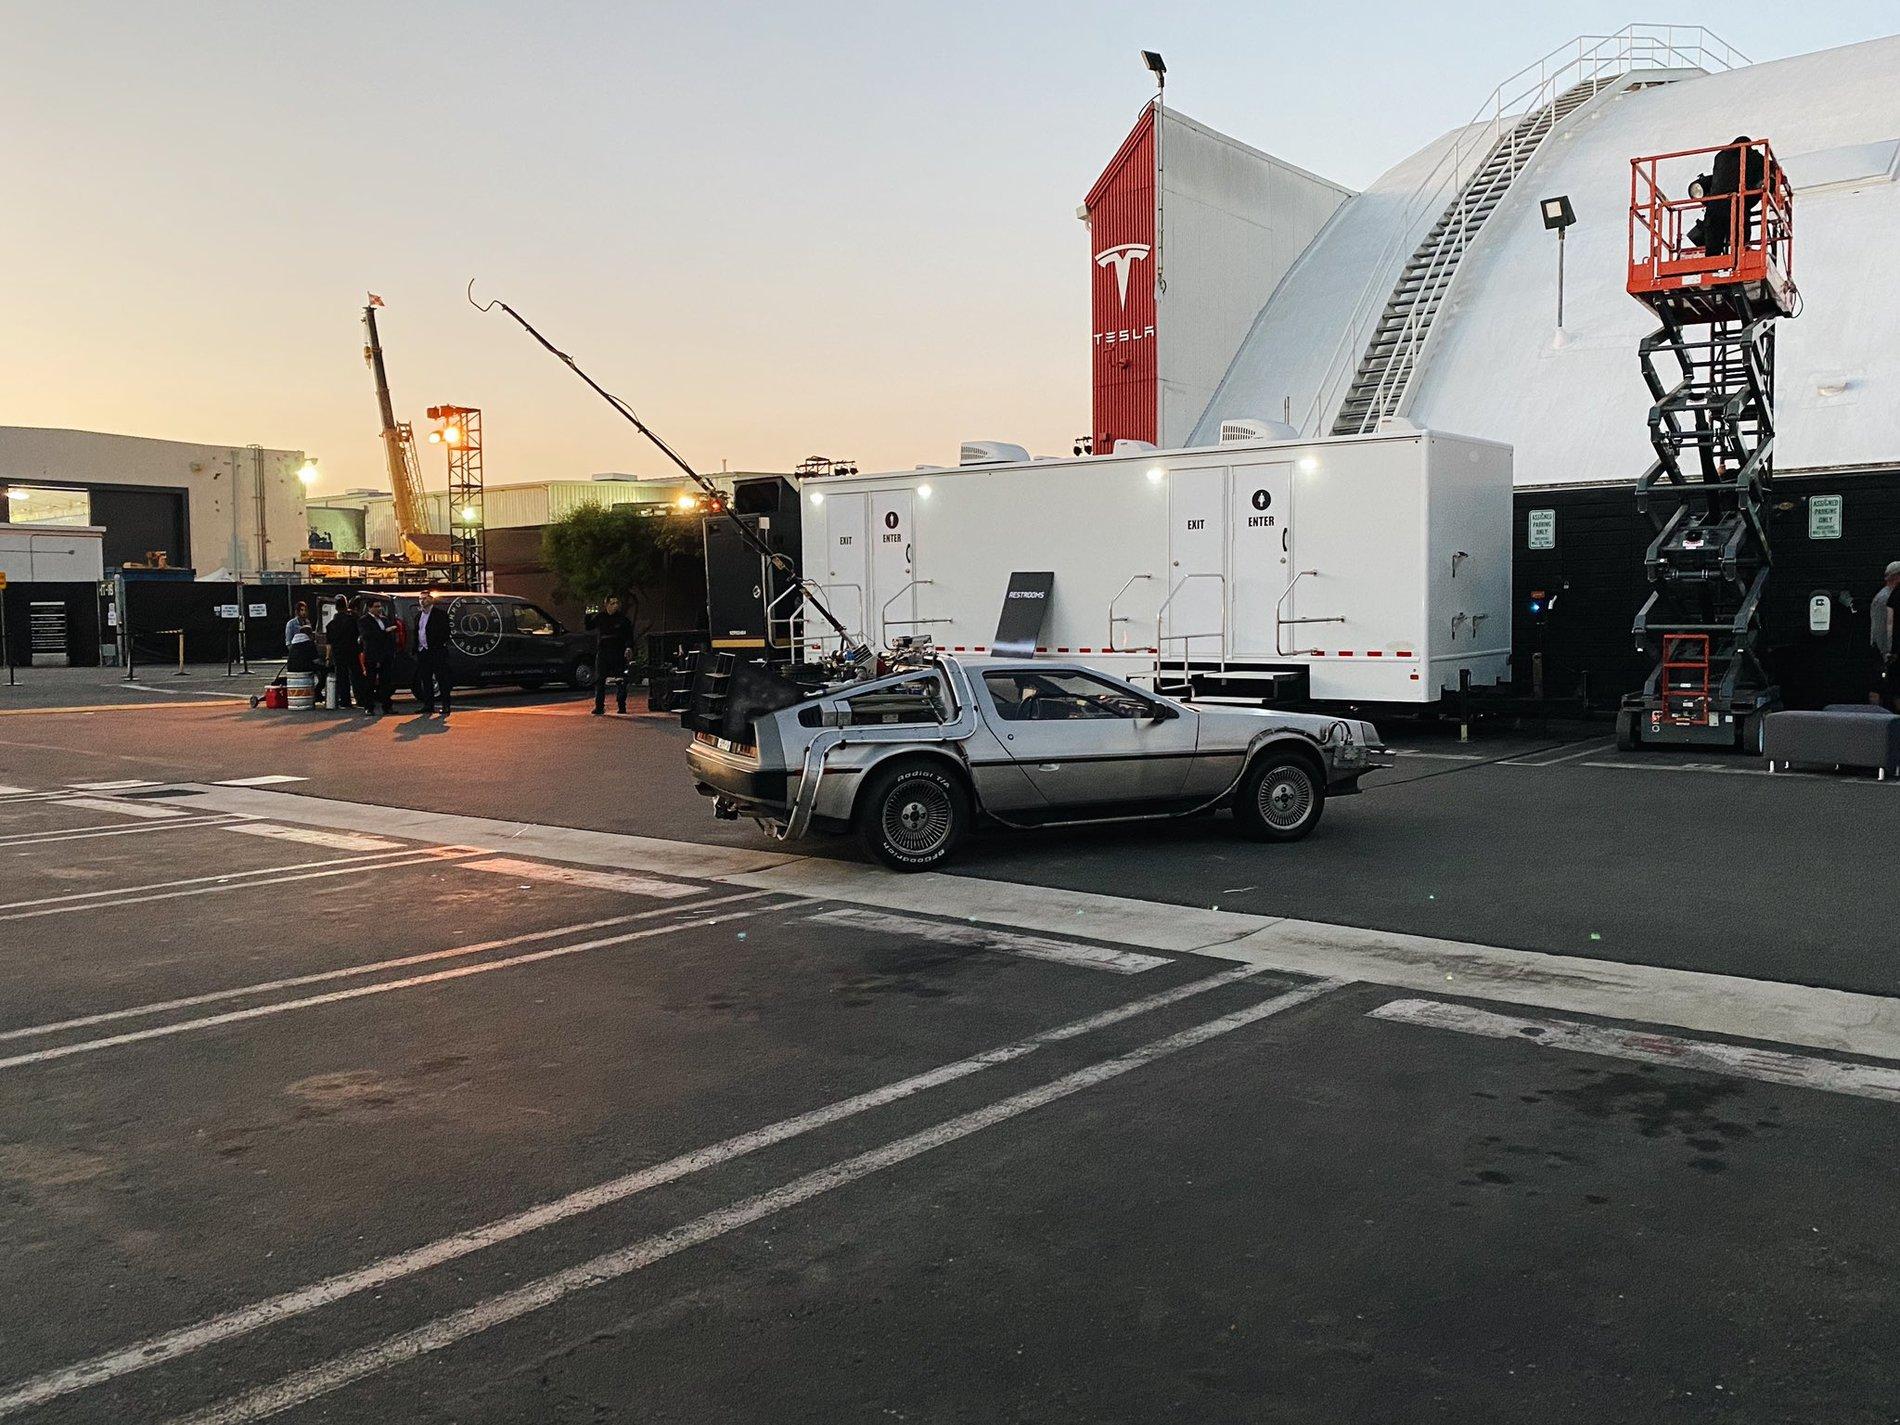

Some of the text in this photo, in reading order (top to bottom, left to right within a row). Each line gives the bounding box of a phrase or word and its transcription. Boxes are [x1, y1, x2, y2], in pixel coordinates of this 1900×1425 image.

[1094, 325, 1155, 346] TESLA
[1187, 519, 1205, 530] EXIT
[1248, 516, 1275, 527] ENTER
[839, 536, 853, 545] EXIT
[882, 533, 902, 543] ENTER
[1008, 591, 1045, 599] RESTROOMS
[897, 770, 934, 782] Radial
[883, 842, 945, 863] BFGoodrich
